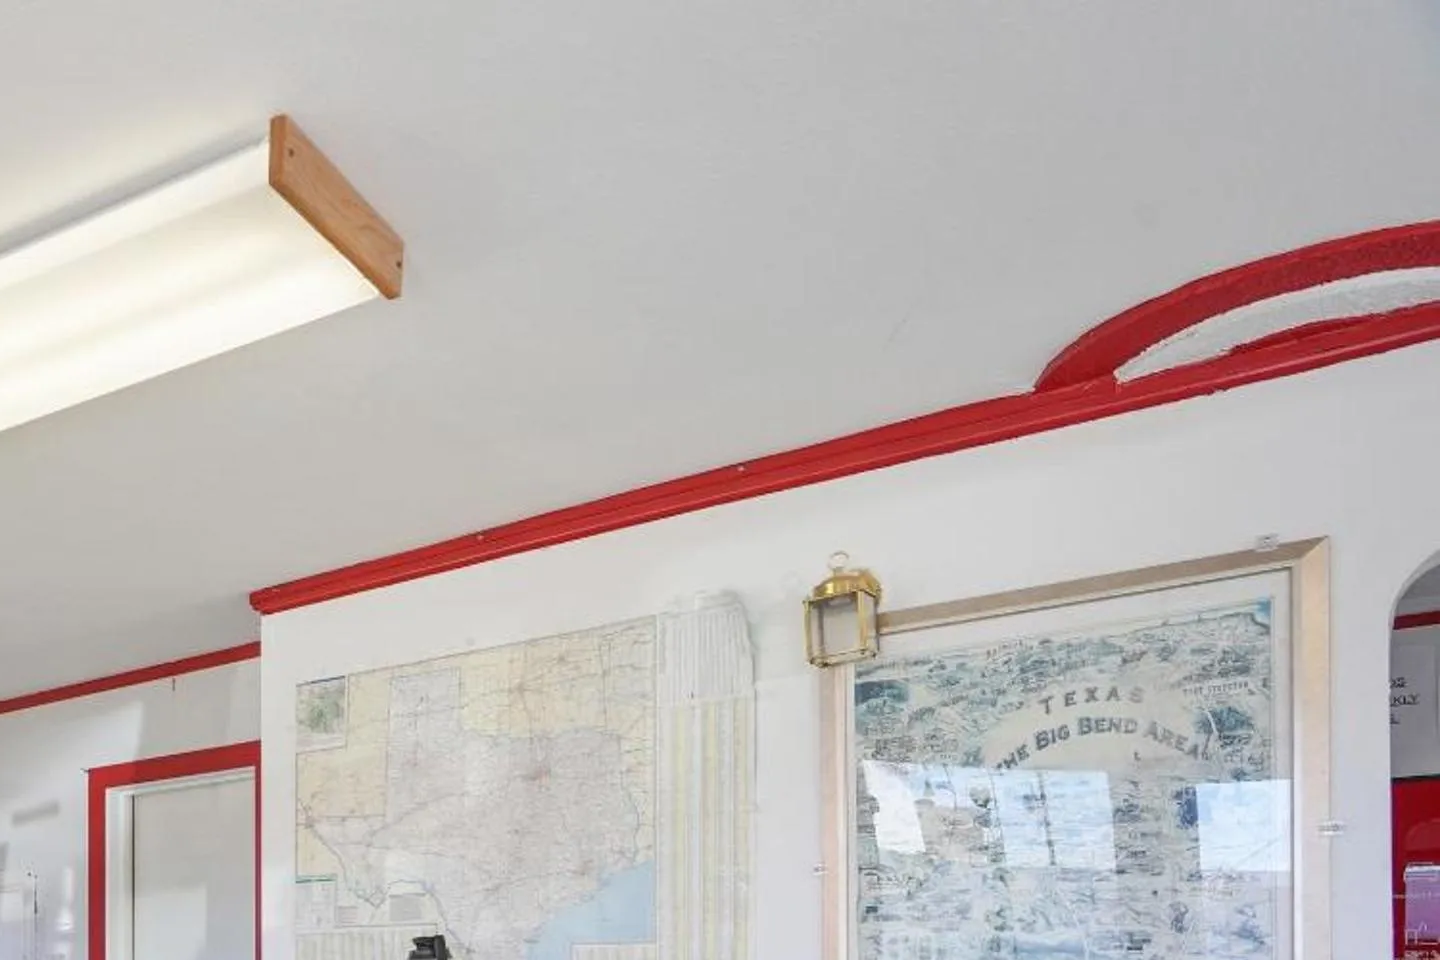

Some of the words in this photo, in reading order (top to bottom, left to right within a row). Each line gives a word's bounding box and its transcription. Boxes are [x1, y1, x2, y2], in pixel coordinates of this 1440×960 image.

[1038, 687, 1144, 715] TEXAS
[1035, 724, 1070, 751] BIG
[1078, 716, 1138, 736] BEND
